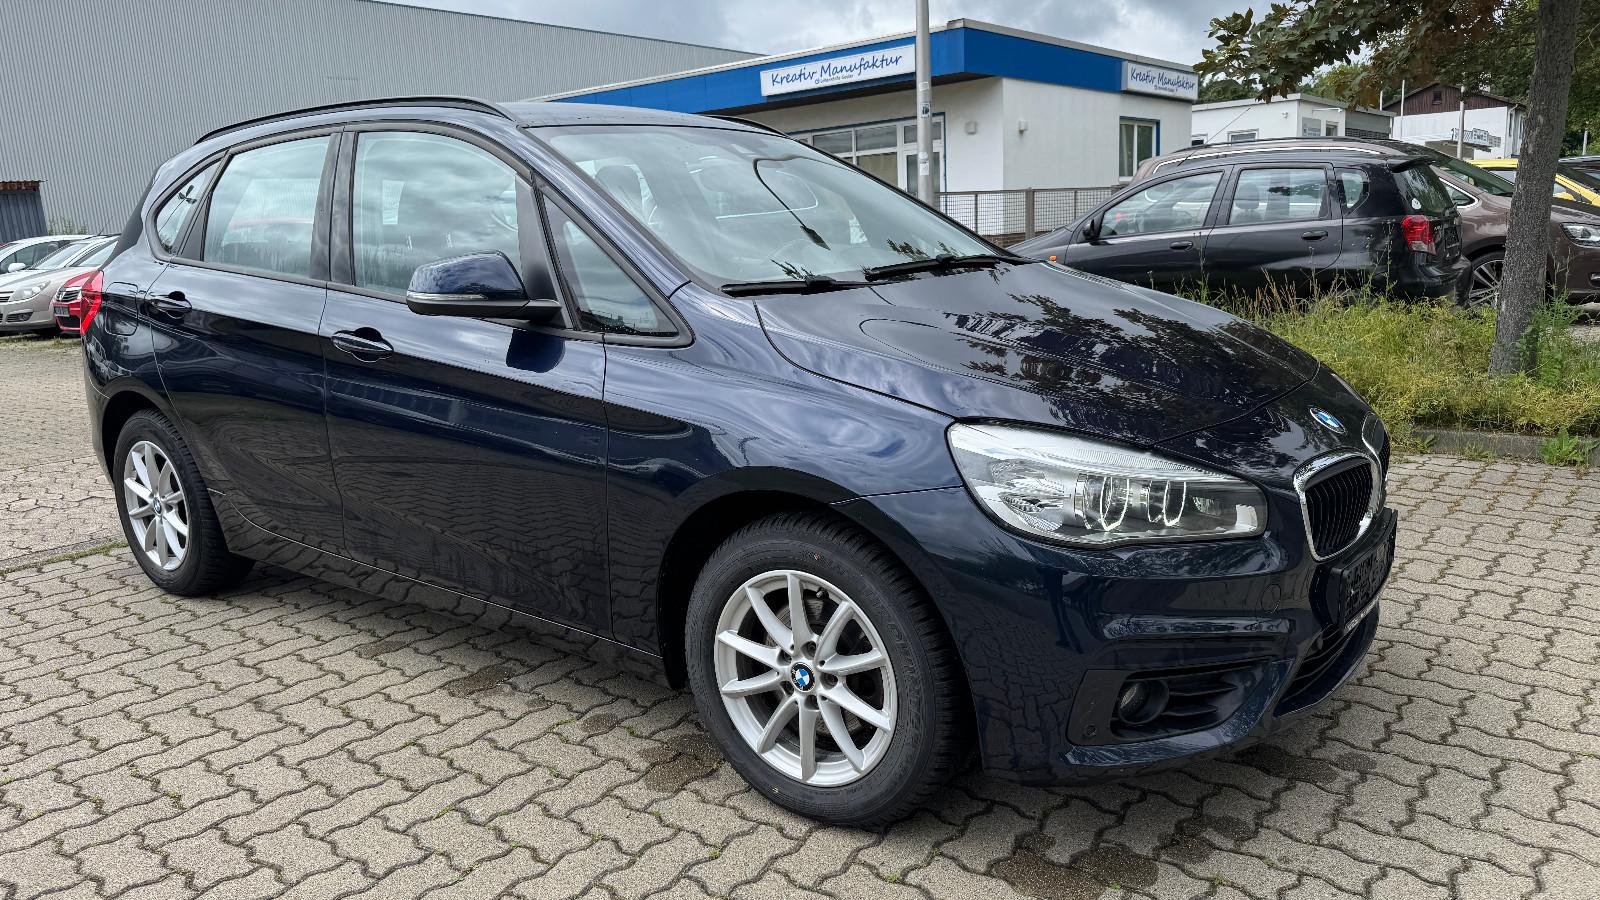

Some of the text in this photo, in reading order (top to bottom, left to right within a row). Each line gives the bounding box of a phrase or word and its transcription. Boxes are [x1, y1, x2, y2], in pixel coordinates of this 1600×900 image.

[771, 67, 817, 86] Kreativ
[820, 54, 903, 78] Manufaktur
[1130, 67, 1156, 84] Kreativ
[1157, 72, 1195, 91] Manufaktur
